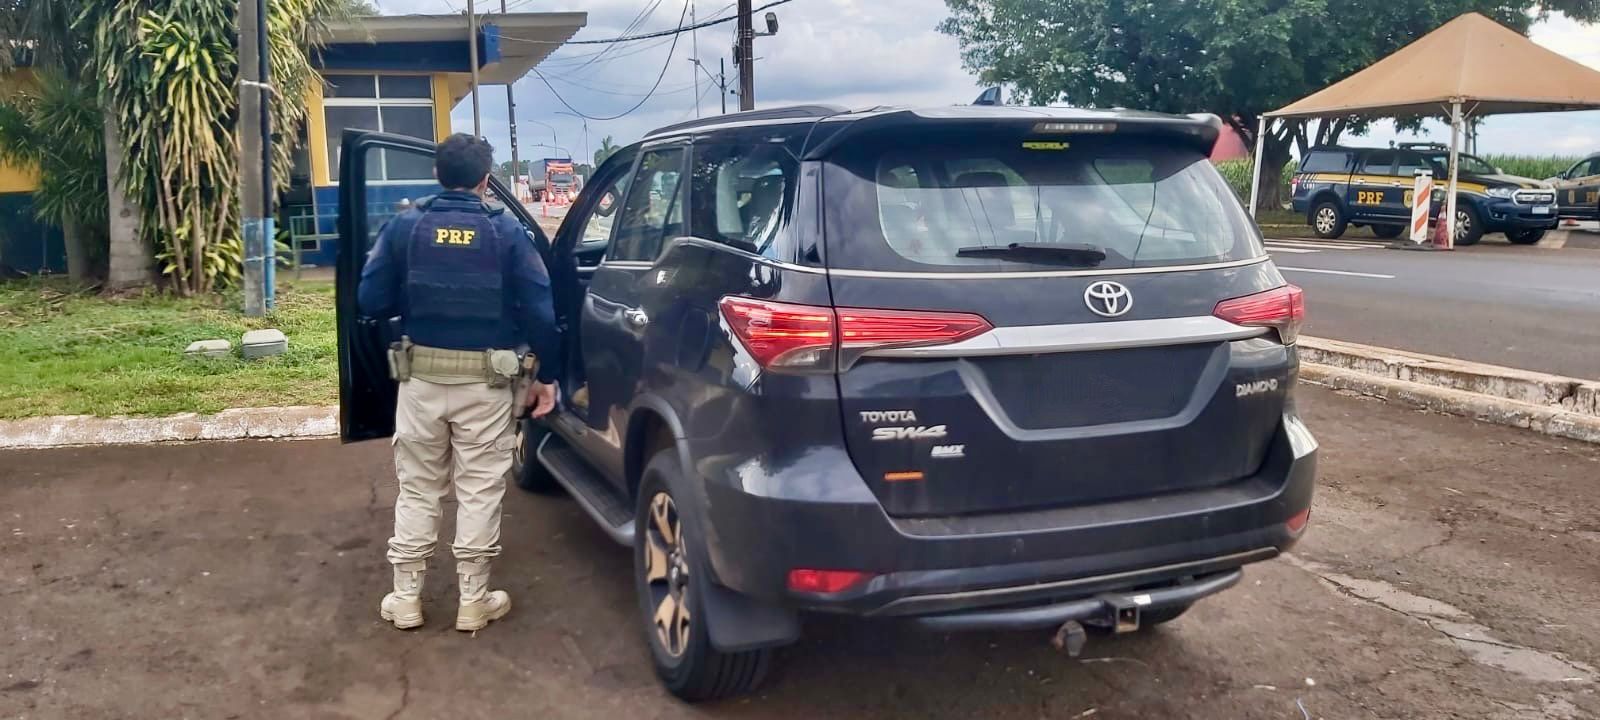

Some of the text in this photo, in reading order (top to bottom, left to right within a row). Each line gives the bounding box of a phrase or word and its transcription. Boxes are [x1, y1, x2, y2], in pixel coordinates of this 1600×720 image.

[1357, 191, 1384, 205] PRF
[436, 228, 475, 245] PRF
[1235, 378, 1279, 397] DIAMOND
[859, 410, 917, 422] TOYOTA
[871, 424, 948, 441] SW4
